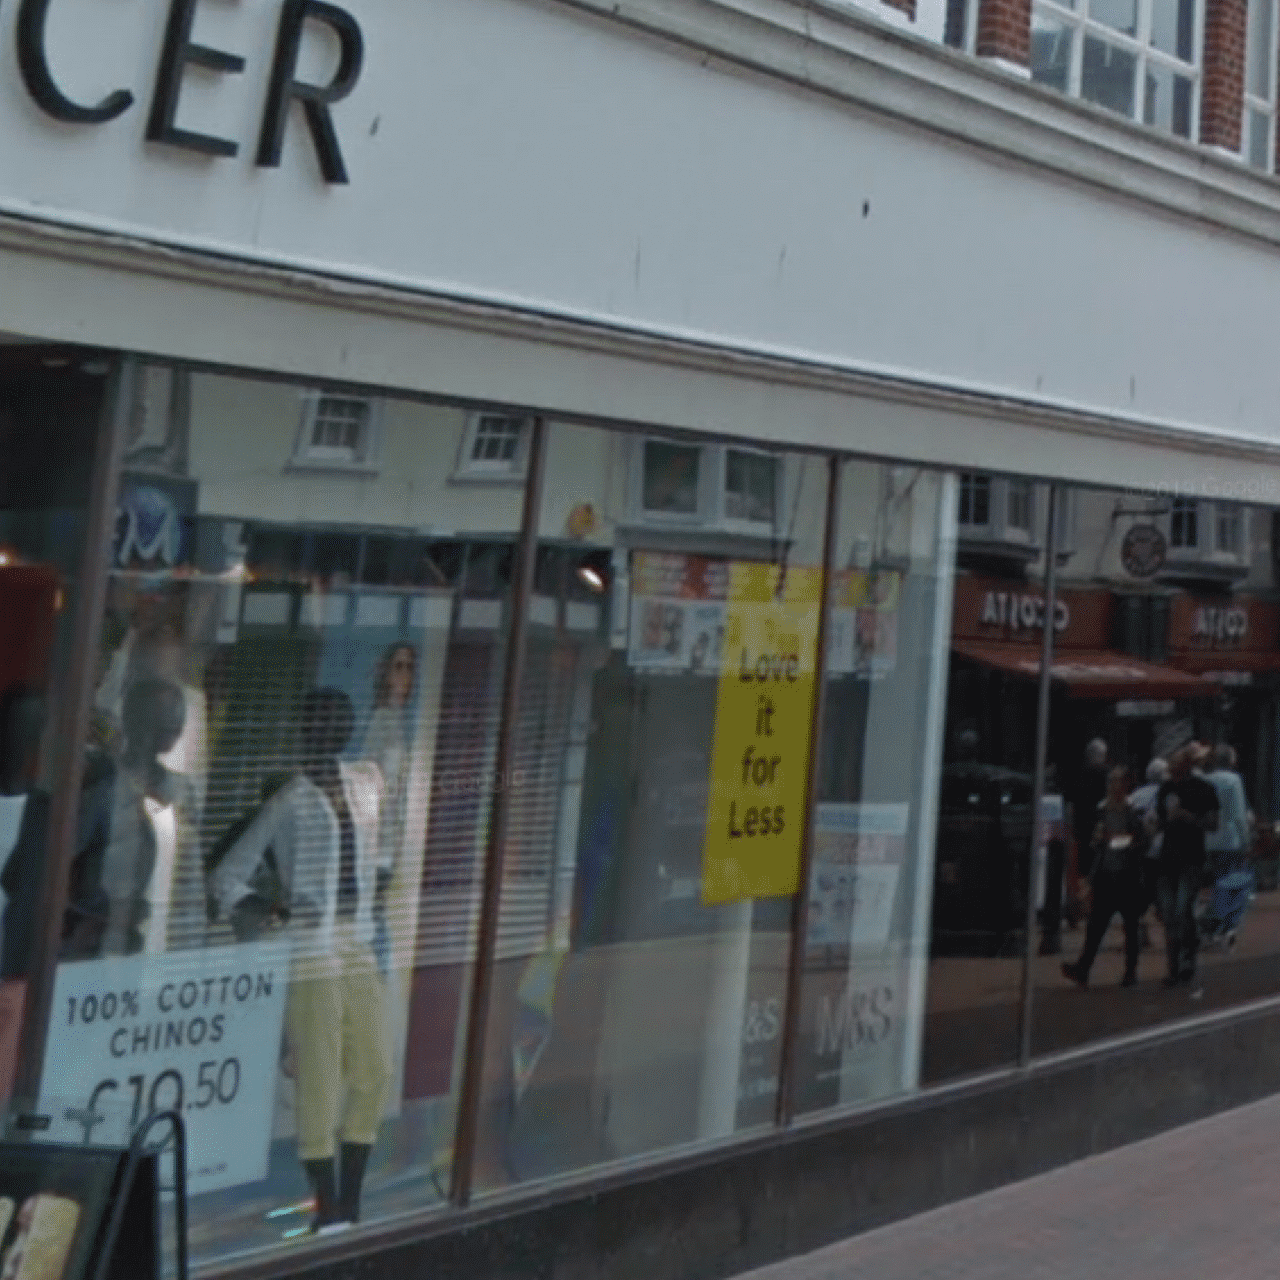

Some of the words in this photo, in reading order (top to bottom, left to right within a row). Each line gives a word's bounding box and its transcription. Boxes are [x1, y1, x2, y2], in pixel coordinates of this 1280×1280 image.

[739, 647, 799, 684] Love
[755, 695, 774, 737] it
[741, 745, 782, 788] for
[727, 800, 785, 840] Less
[65, 989, 141, 1027] 100%
[156, 971, 275, 1014] COTTON
[109, 1013, 226, 1058] CHINOS
